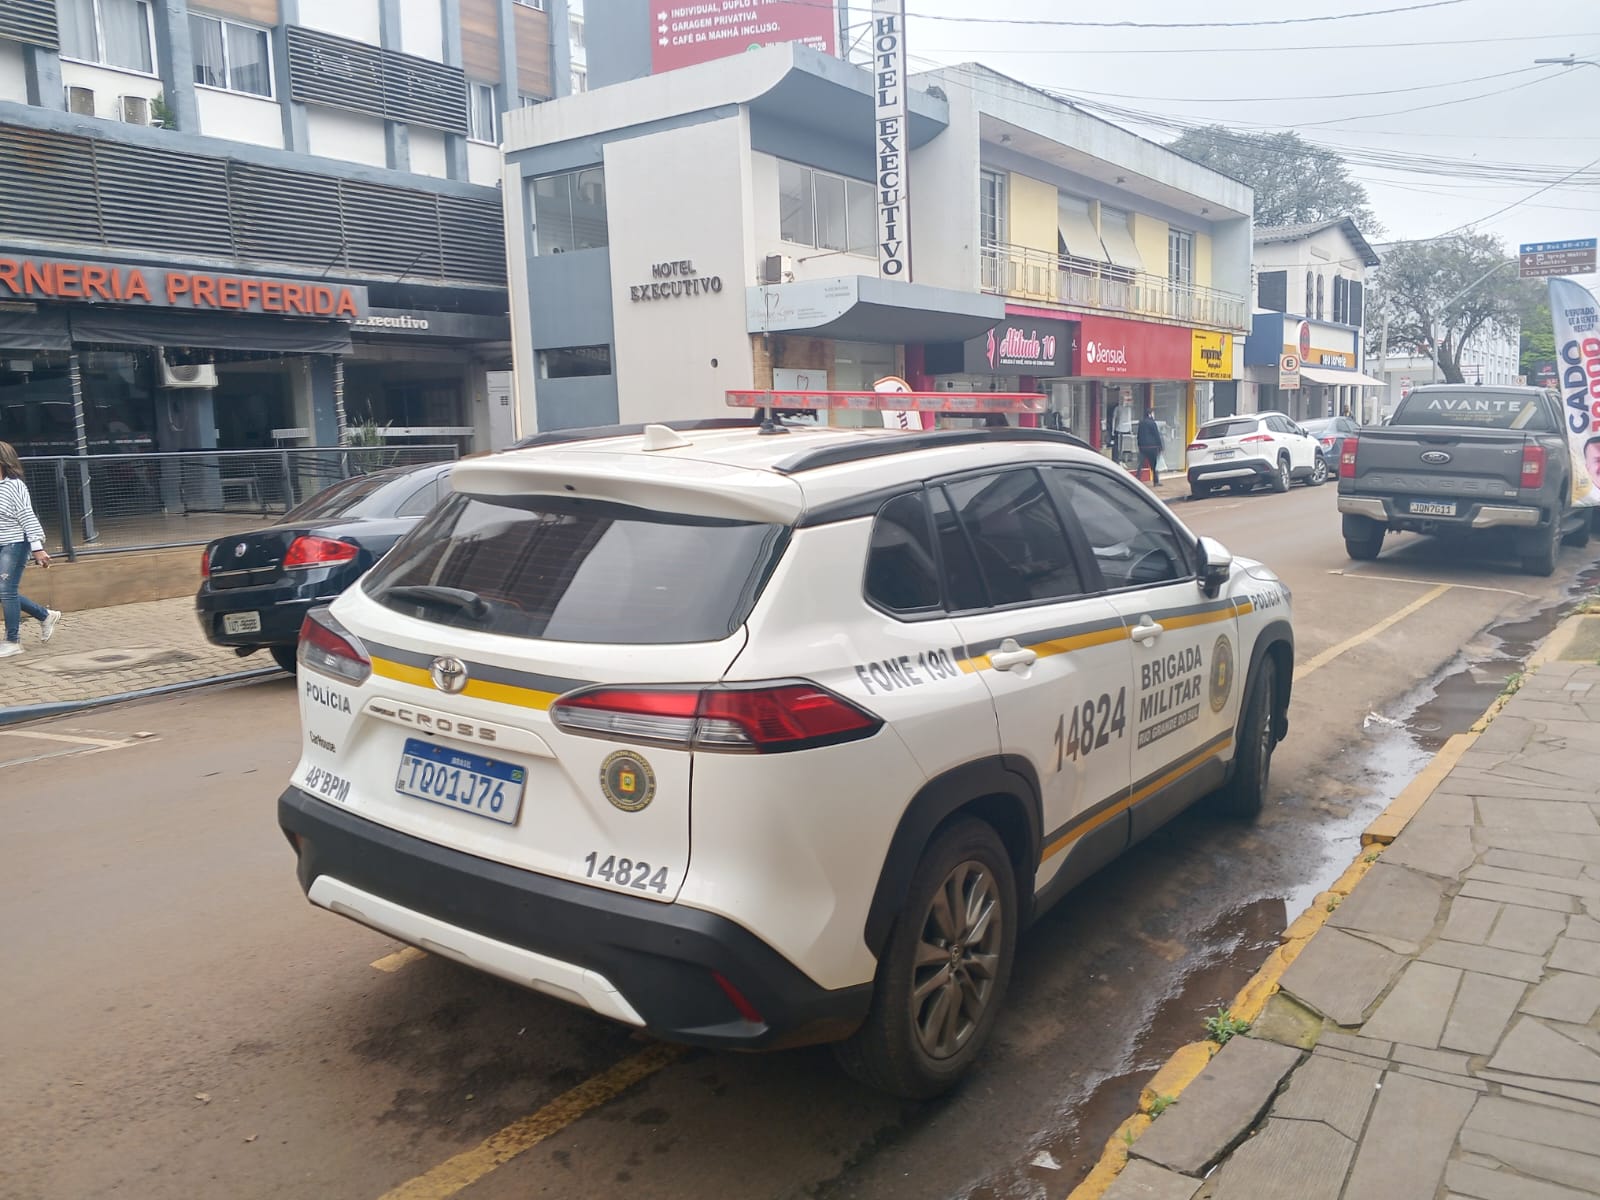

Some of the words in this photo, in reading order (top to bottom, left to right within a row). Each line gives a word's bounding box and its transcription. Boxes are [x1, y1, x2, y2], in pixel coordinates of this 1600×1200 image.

[671, 18, 712, 32] GARAGEM
[714, 11, 757, 25] PRIVATIVA
[695, 32, 708, 43] DA
[876, 16, 897, 107] HOTEL
[879, 118, 903, 276] EXECUTIVO
[652, 260, 696, 277] HOTEL
[0, 258, 152, 302] RNERIA
[166, 272, 359, 318] PREFERIDA
[630, 276, 723, 303] EXECUTIVO
[1042, 336, 1056, 360] 10
[1096, 342, 1127, 365] Sensual
[1286, 359, 1294, 367] E
[1562, 340, 1590, 434] CADO
[1427, 400, 1520, 412] AVANTE
[856, 655, 920, 696] FONE
[918, 648, 958, 681] 190
[1141, 644, 1202, 691] BRIGADA
[306, 680, 352, 716] POLÍCIA
[1139, 675, 1201, 724] MILITAR
[397, 708, 497, 741] CROSS
[1054, 686, 1126, 772] 14824
[585, 851, 669, 894] 14824
